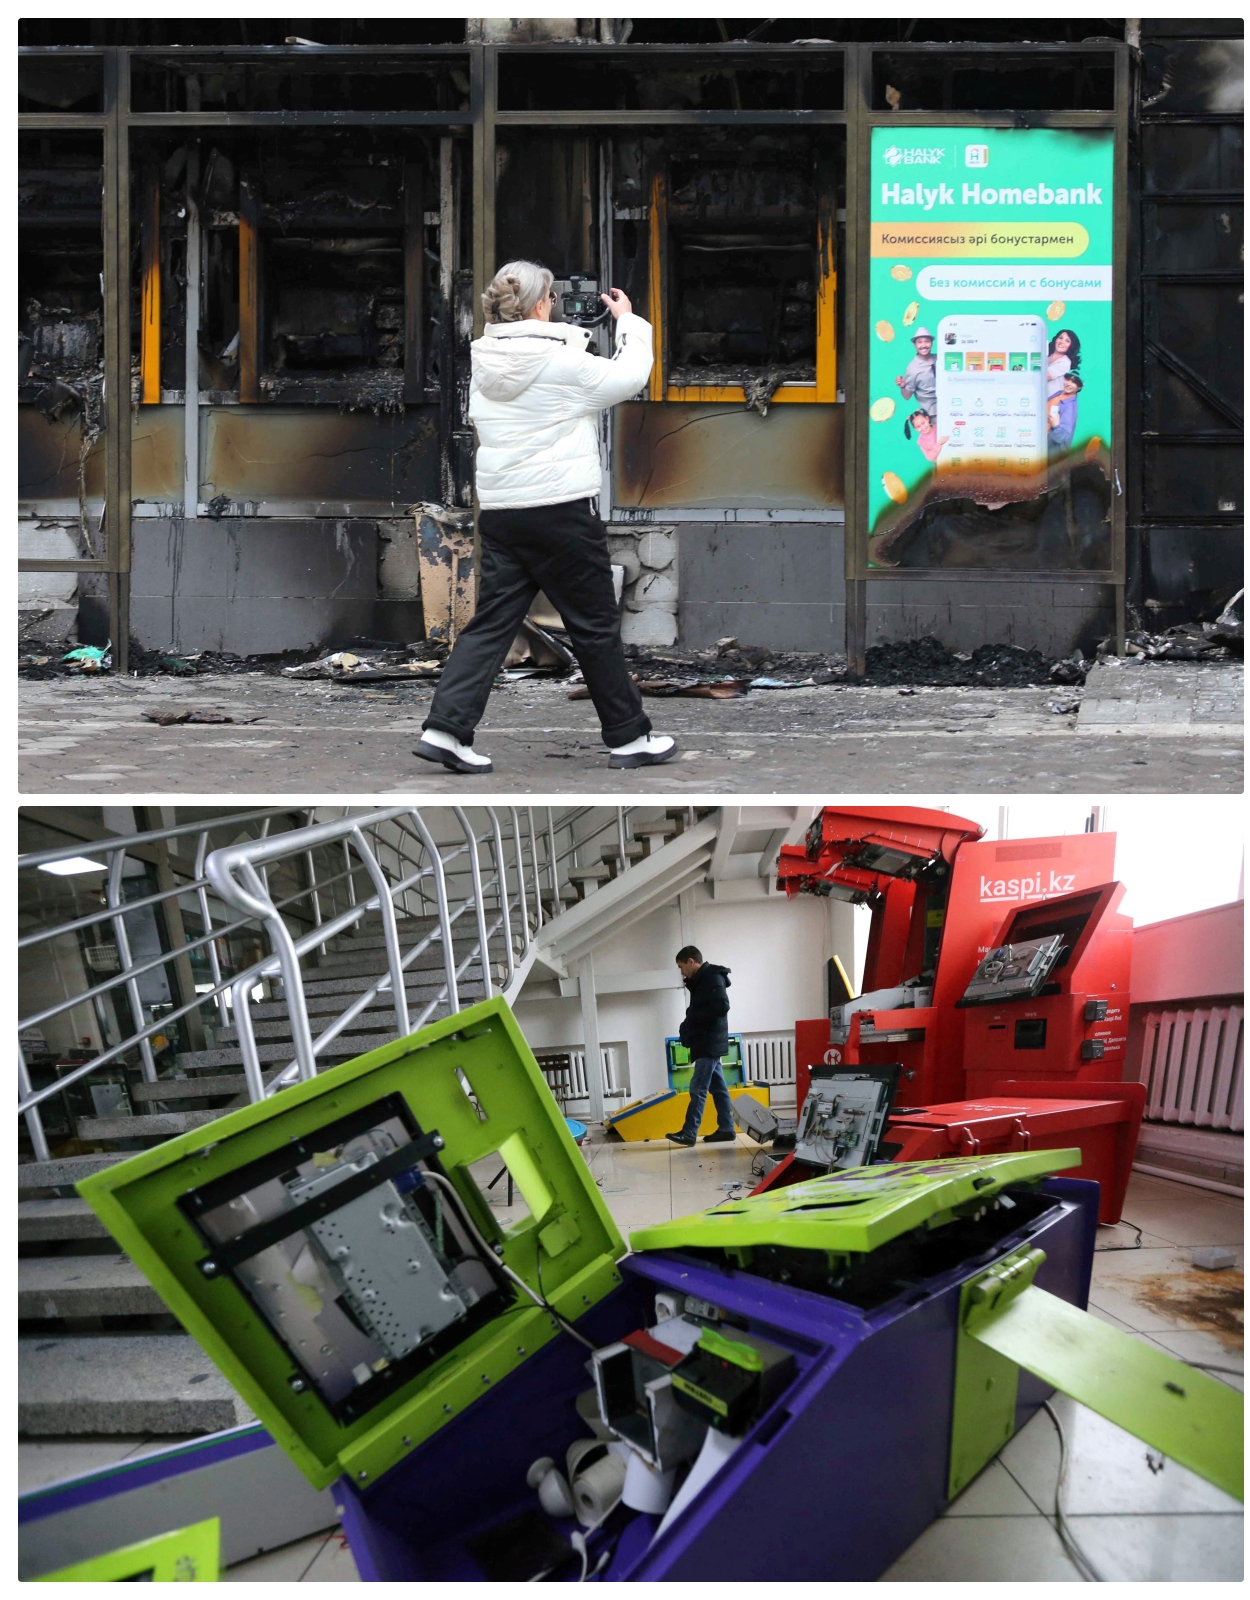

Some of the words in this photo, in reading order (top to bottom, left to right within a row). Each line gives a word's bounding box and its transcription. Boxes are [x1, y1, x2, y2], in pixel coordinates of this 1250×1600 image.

[904, 148, 945, 156] HALYK
[904, 156, 941, 164] BANK
[881, 183, 955, 211] Halyk
[962, 183, 1103, 205] Homebank
[882, 233, 965, 245] Комиссиясыз
[969, 233, 987, 248] әрі
[990, 233, 1074, 248] бонустармен
[929, 277, 950, 288] Без
[953, 277, 1015, 288] комиссий
[1018, 280, 1026, 288] и
[1030, 280, 1036, 288] с
[1040, 277, 1102, 291] бонусами
[980, 870, 1076, 900] kaspi.kz
